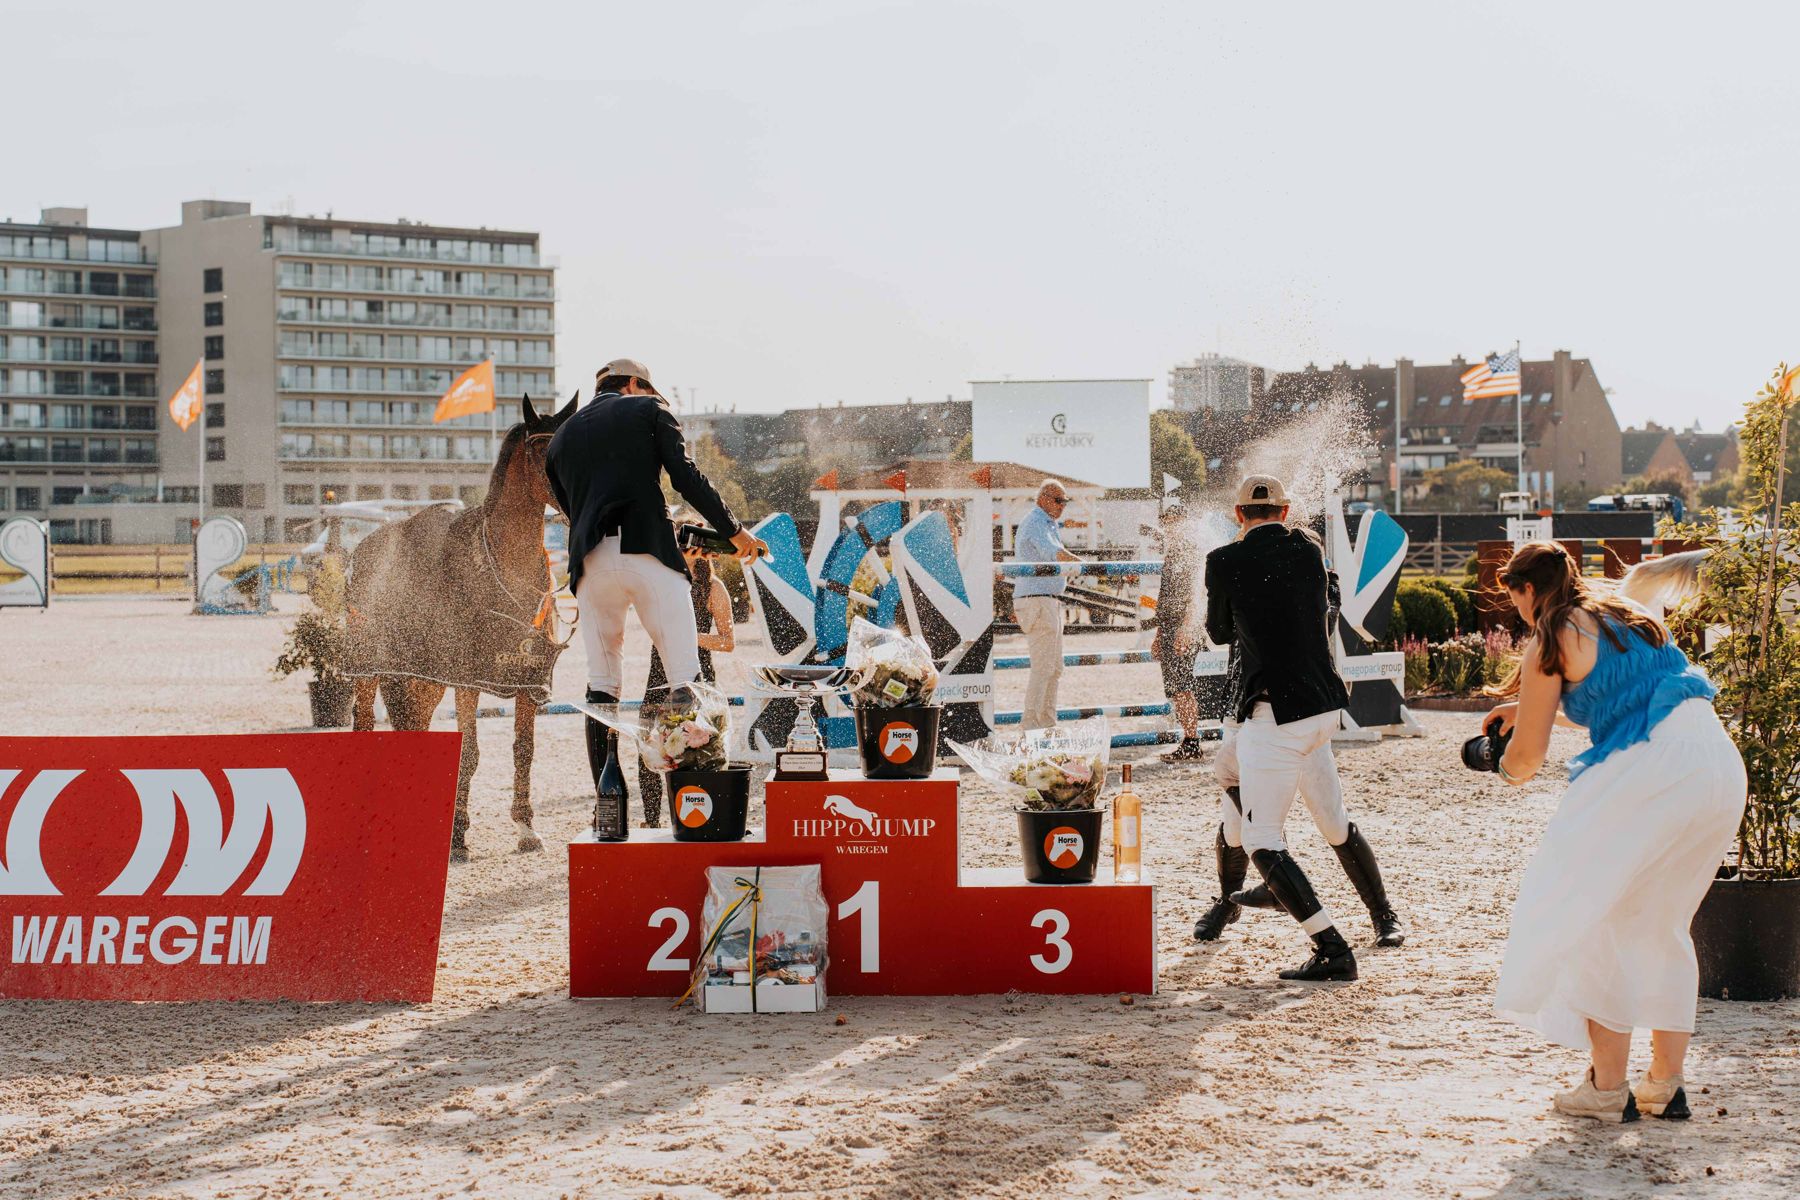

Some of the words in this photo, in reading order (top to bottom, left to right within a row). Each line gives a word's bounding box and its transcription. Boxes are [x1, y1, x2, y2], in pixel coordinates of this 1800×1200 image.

[892, 731, 912, 739] Horse
[685, 795, 705, 803] Horse
[793, 819, 864, 837] HIPPO
[871, 818, 936, 837] JUMP
[1057, 836, 1078, 844] Horse
[836, 845, 888, 854] WAREGEM
[647, 907, 691, 971] 2
[837, 880, 880, 973] 1
[1029, 909, 1074, 974] 3
[11, 915, 273, 965] WAREGEM
